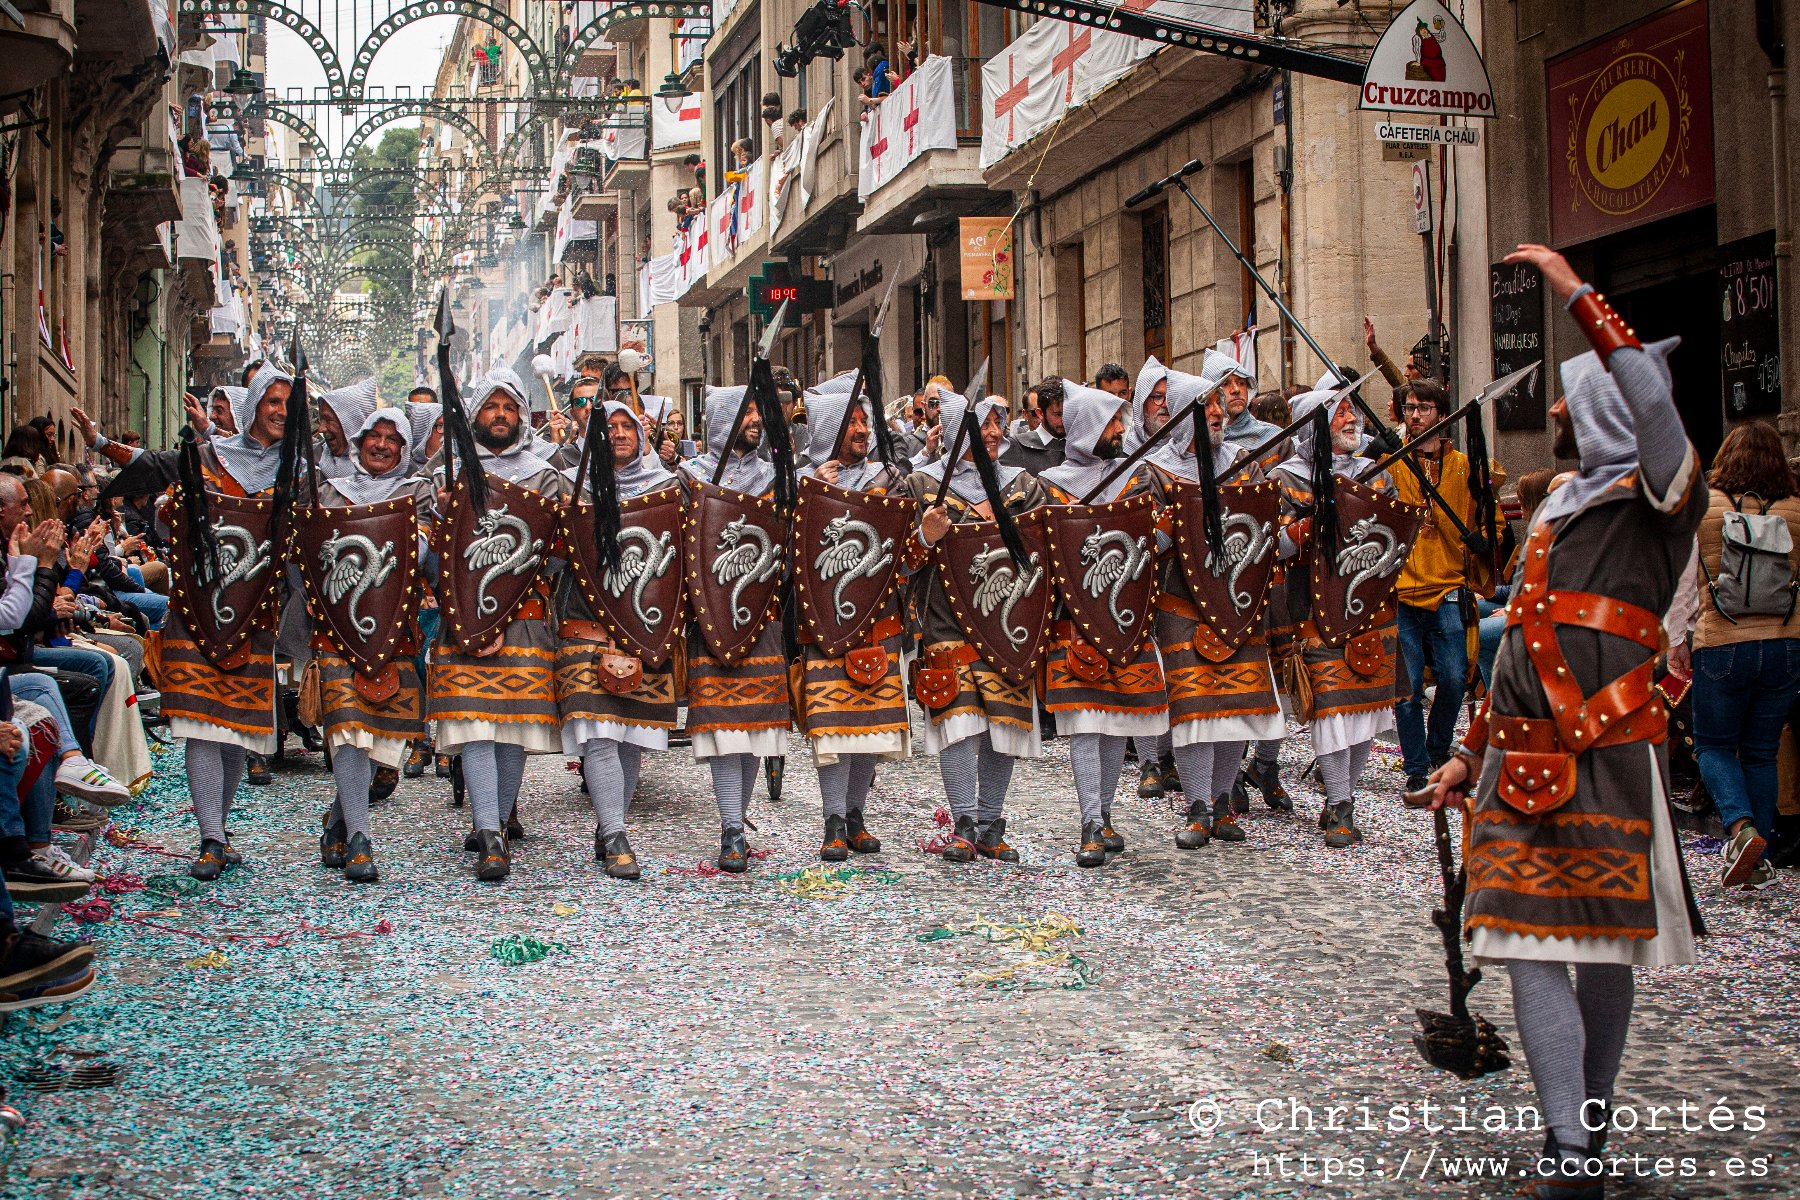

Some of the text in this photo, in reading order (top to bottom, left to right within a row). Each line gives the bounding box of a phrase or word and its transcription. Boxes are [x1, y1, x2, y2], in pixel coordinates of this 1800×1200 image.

[1593, 57, 1657, 101] CHURRERÍA
[1364, 82, 1491, 113] Cruzcampo
[1380, 126, 1475, 144] CAFETERÍA CHAU
[1596, 100, 1658, 173] Chau
[1493, 331, 1538, 352] HAMBURGUESAS
